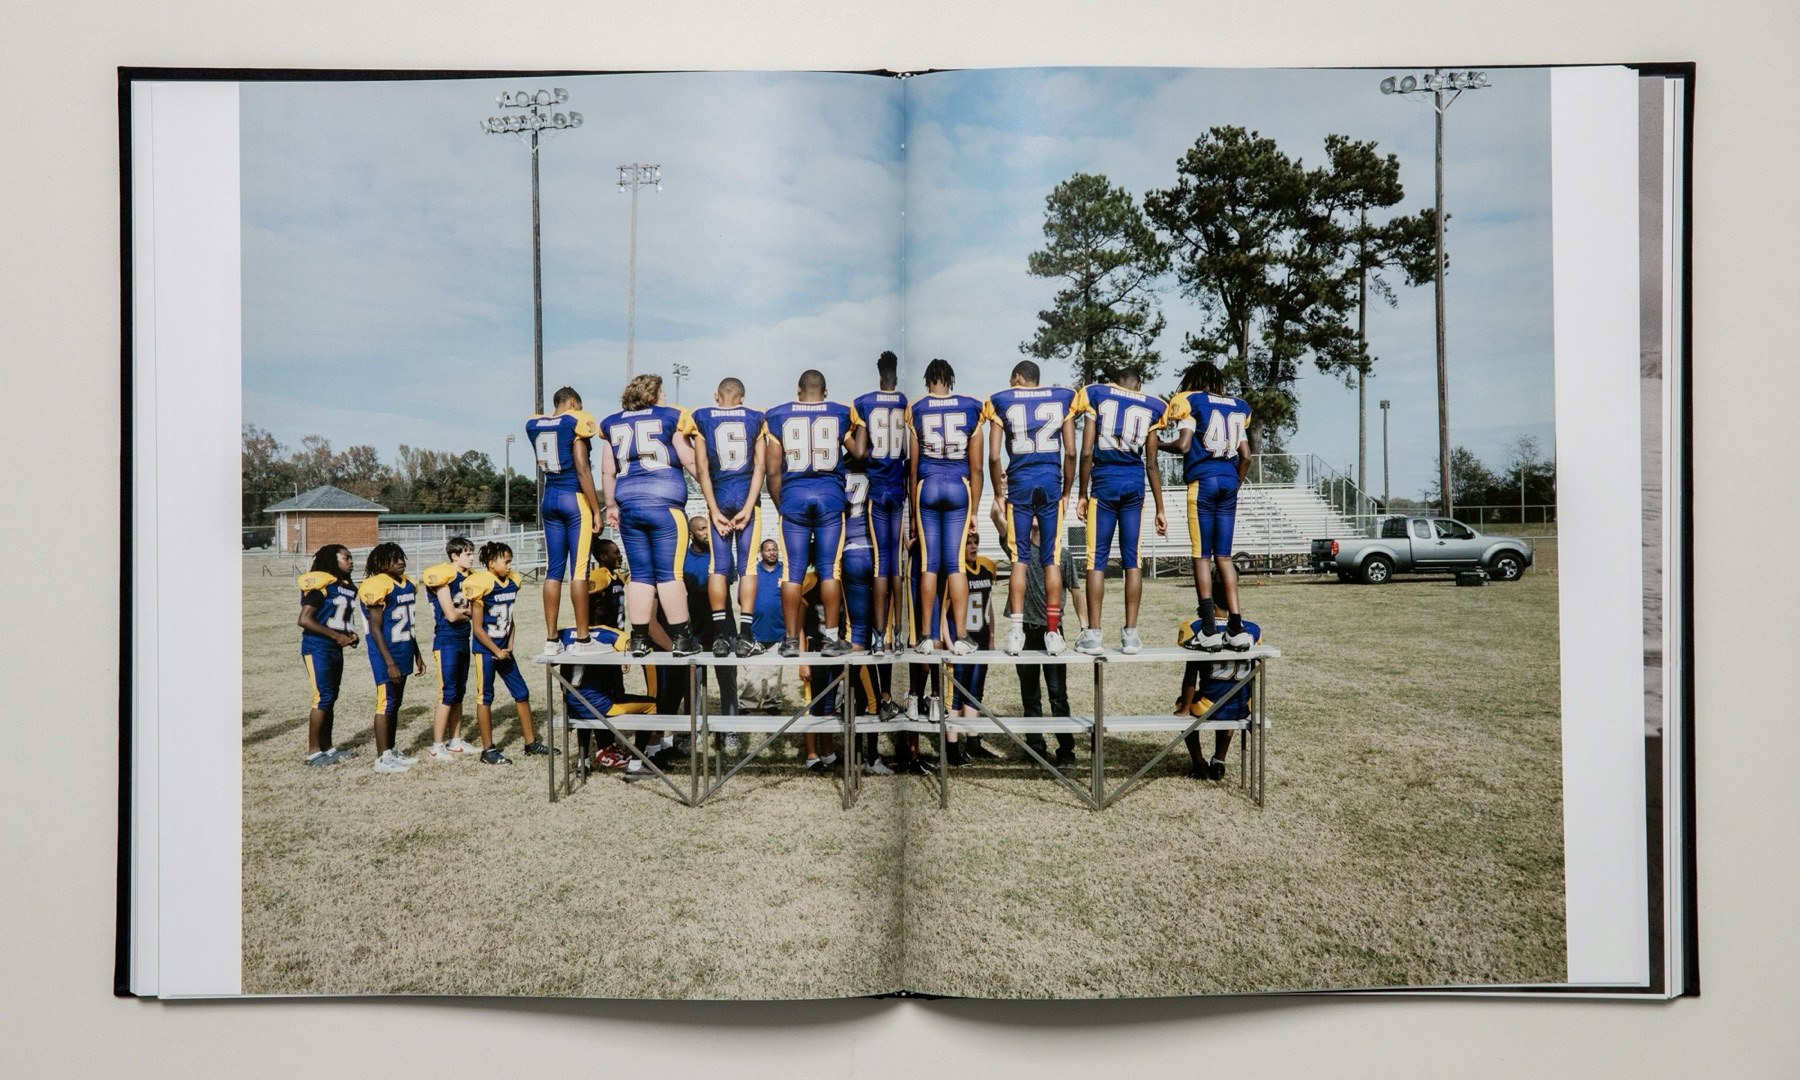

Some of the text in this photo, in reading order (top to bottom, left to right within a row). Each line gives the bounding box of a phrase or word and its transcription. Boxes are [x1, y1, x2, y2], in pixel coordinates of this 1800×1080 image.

[609, 419, 671, 478] 75
[714, 421, 748, 472] 6
[782, 416, 839, 472] 99
[869, 407, 905, 460] 66
[921, 412, 969, 460] 55
[1006, 402, 1063, 454] 12
[1099, 399, 1153, 454] 10
[1203, 409, 1247, 460] 40
[535, 431, 562, 474] 9
[845, 473, 870, 518] 7
